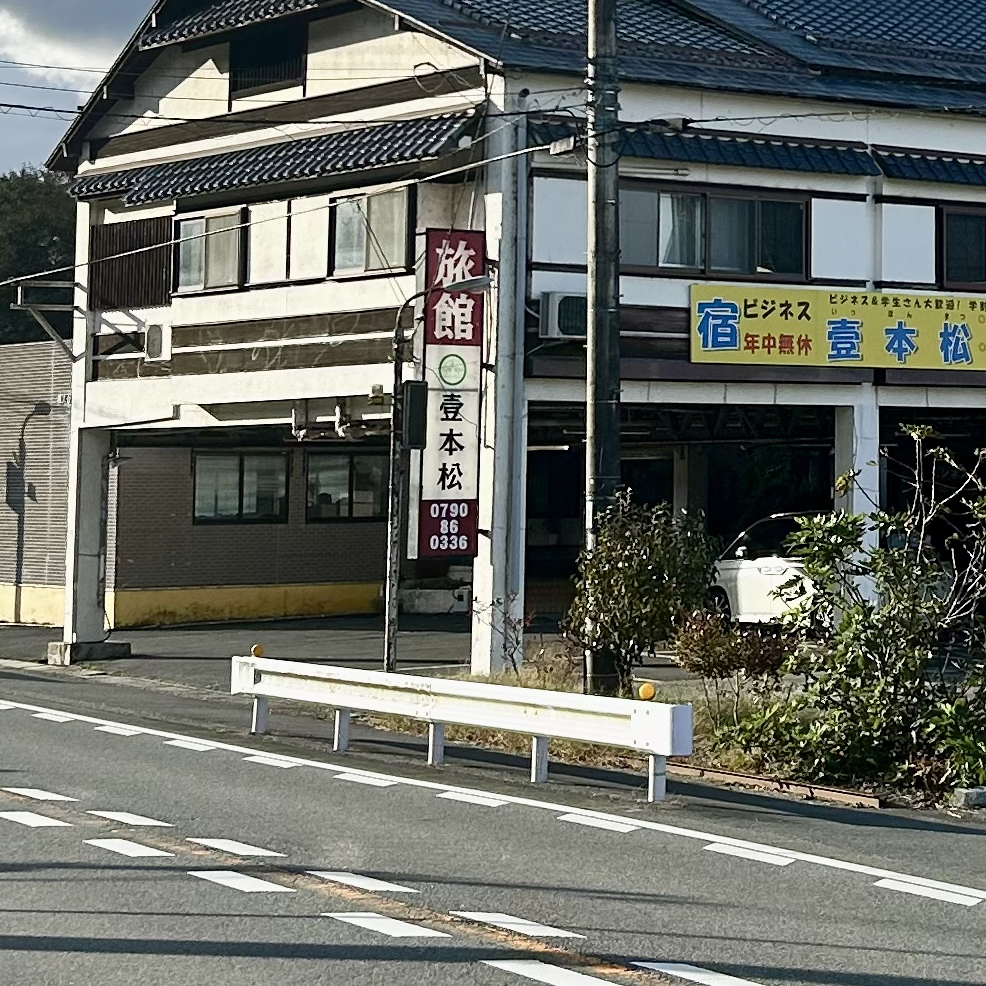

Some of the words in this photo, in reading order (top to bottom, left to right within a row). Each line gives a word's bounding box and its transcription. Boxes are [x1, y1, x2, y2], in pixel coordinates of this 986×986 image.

[432, 239, 476, 340] 旅館
[743, 298, 812, 321] ビジネス
[697, 297, 740, 351] 宿
[743, 332, 813, 356] 年中無休
[430, 502, 468, 518] 0790
[440, 519, 459, 534] 86
[430, 534, 468, 550] 0336
